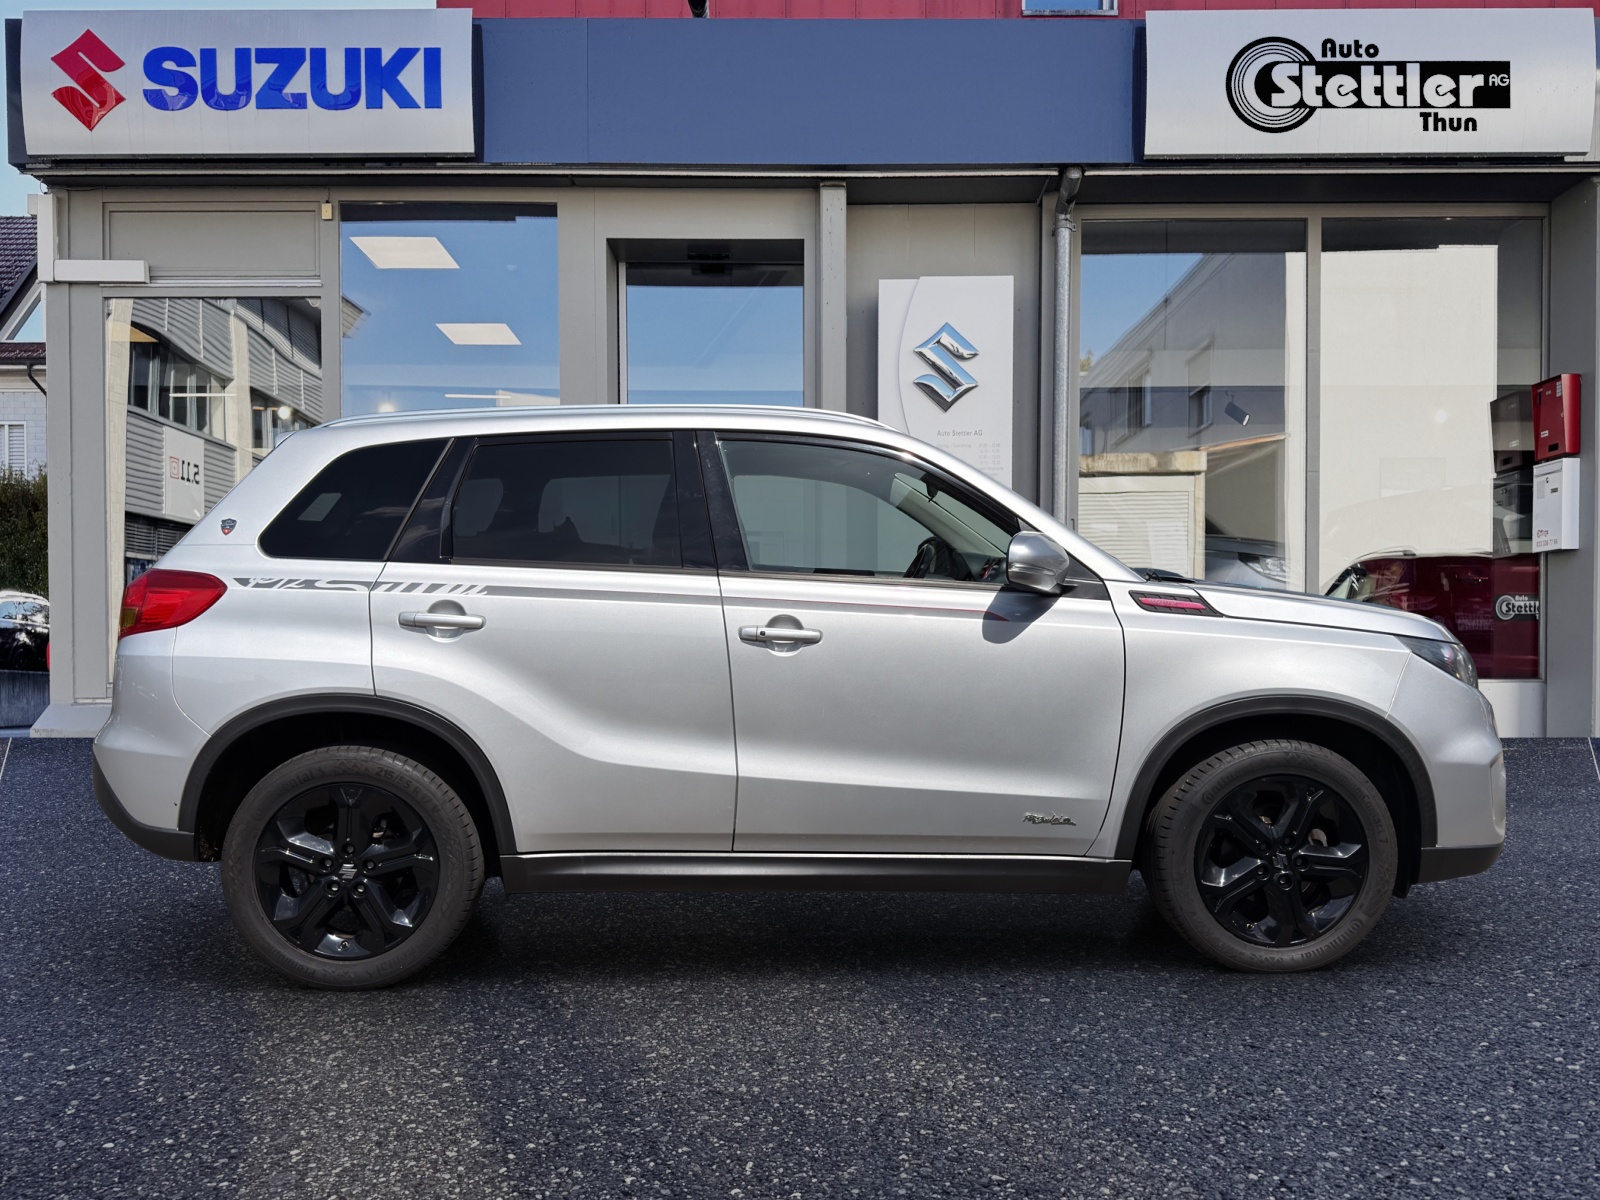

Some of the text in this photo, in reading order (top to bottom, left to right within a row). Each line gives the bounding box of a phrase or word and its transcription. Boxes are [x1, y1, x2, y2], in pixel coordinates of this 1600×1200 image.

[1321, 38, 1380, 58] Auto
[143, 46, 442, 111] SUZUKI
[1271, 62, 1510, 107] Stettler AG
[1420, 112, 1478, 131] Thun
